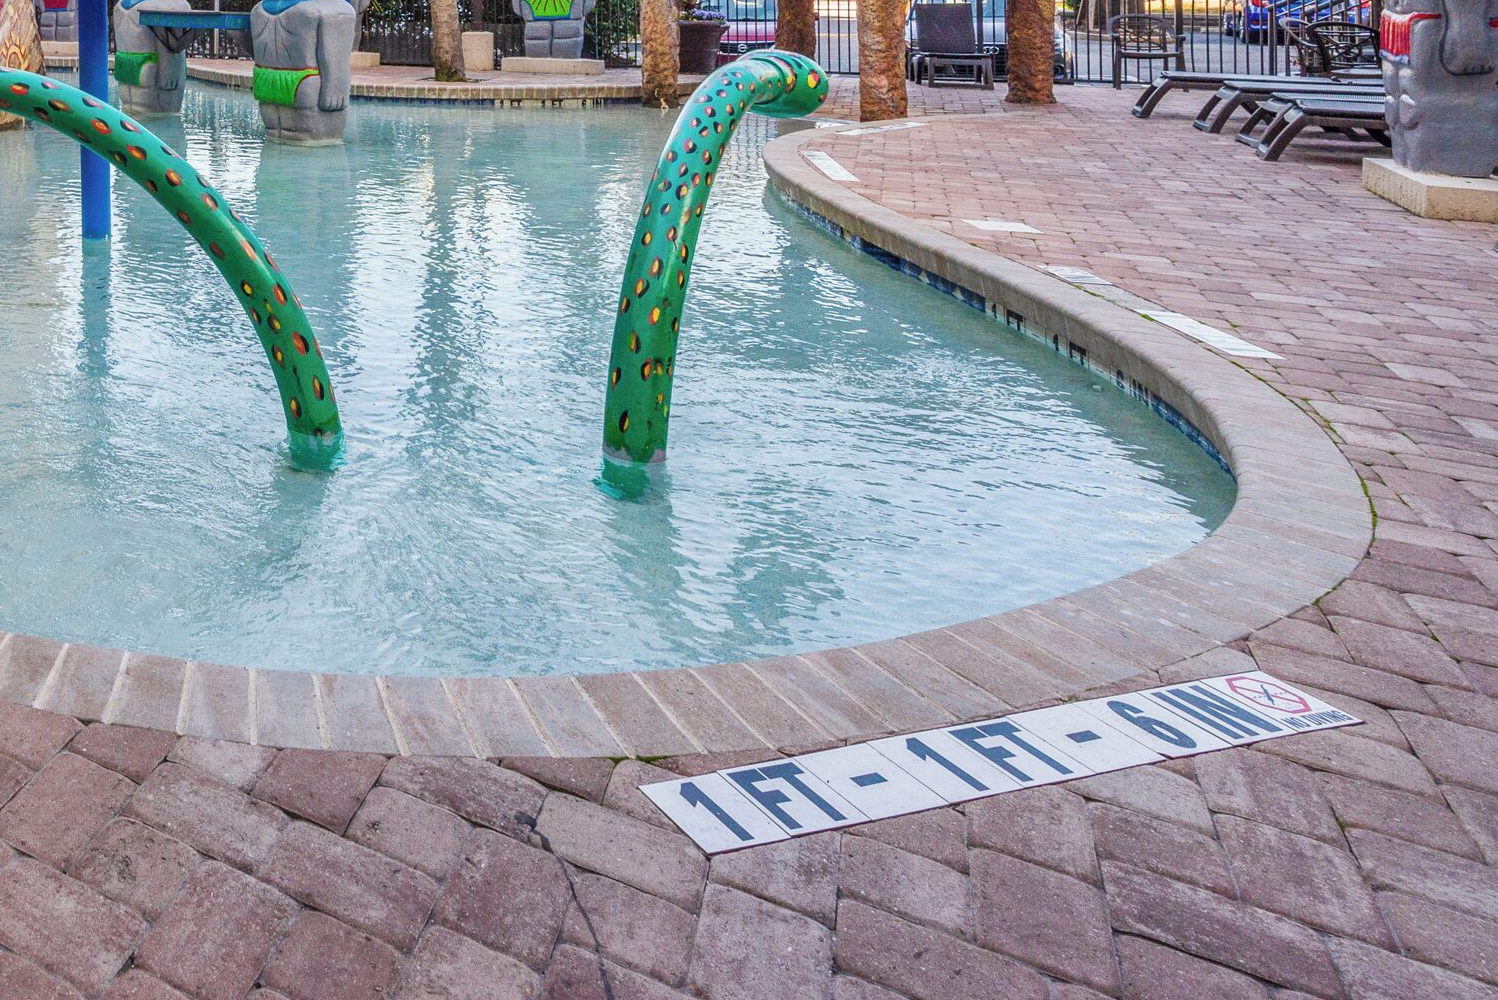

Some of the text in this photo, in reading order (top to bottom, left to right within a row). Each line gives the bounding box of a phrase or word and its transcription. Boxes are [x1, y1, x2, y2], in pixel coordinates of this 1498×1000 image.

[1107, 701, 1197, 749] 6
[1150, 685, 1284, 740] IN
[1280, 710, 1352, 729] NO DIVING
[905, 737, 990, 792] 1
[947, 721, 1074, 782] FT
[679, 781, 755, 842] 1
[726, 762, 848, 830] FT
